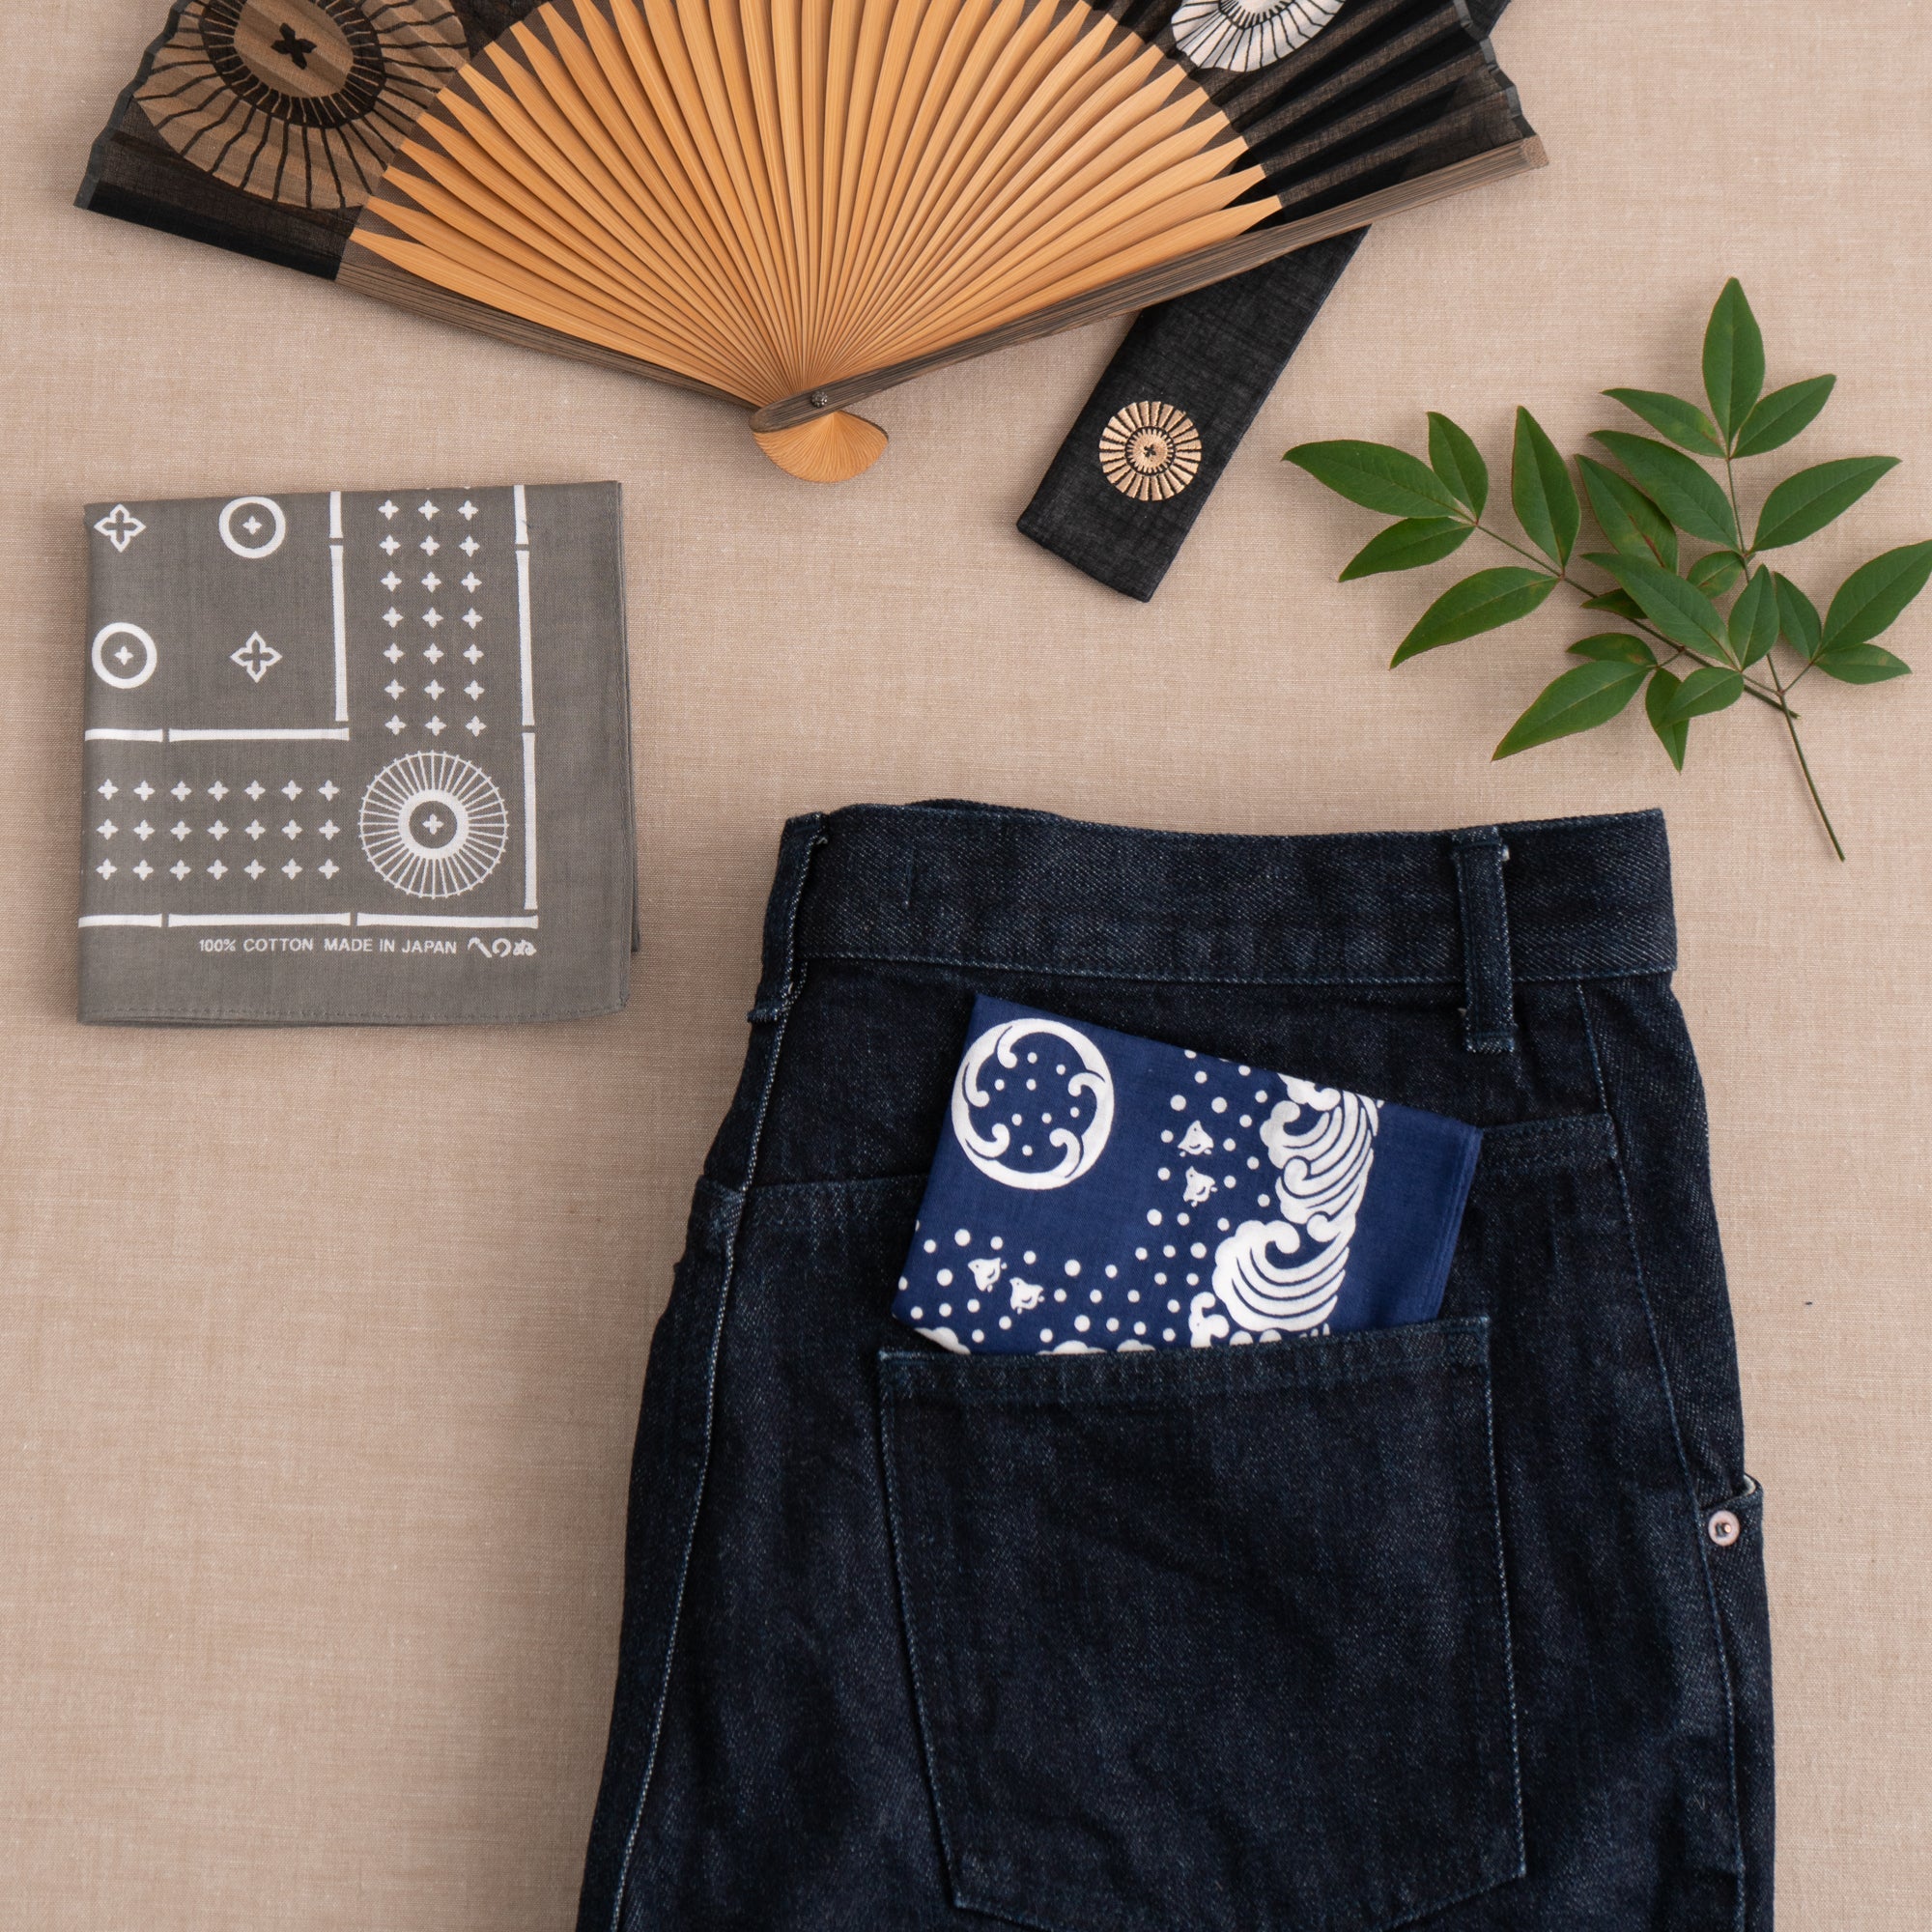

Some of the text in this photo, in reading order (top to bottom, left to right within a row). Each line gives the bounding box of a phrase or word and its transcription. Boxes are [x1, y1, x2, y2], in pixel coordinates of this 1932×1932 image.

[199, 937, 457, 954] 100% COTTON MADE IN JAPAN
